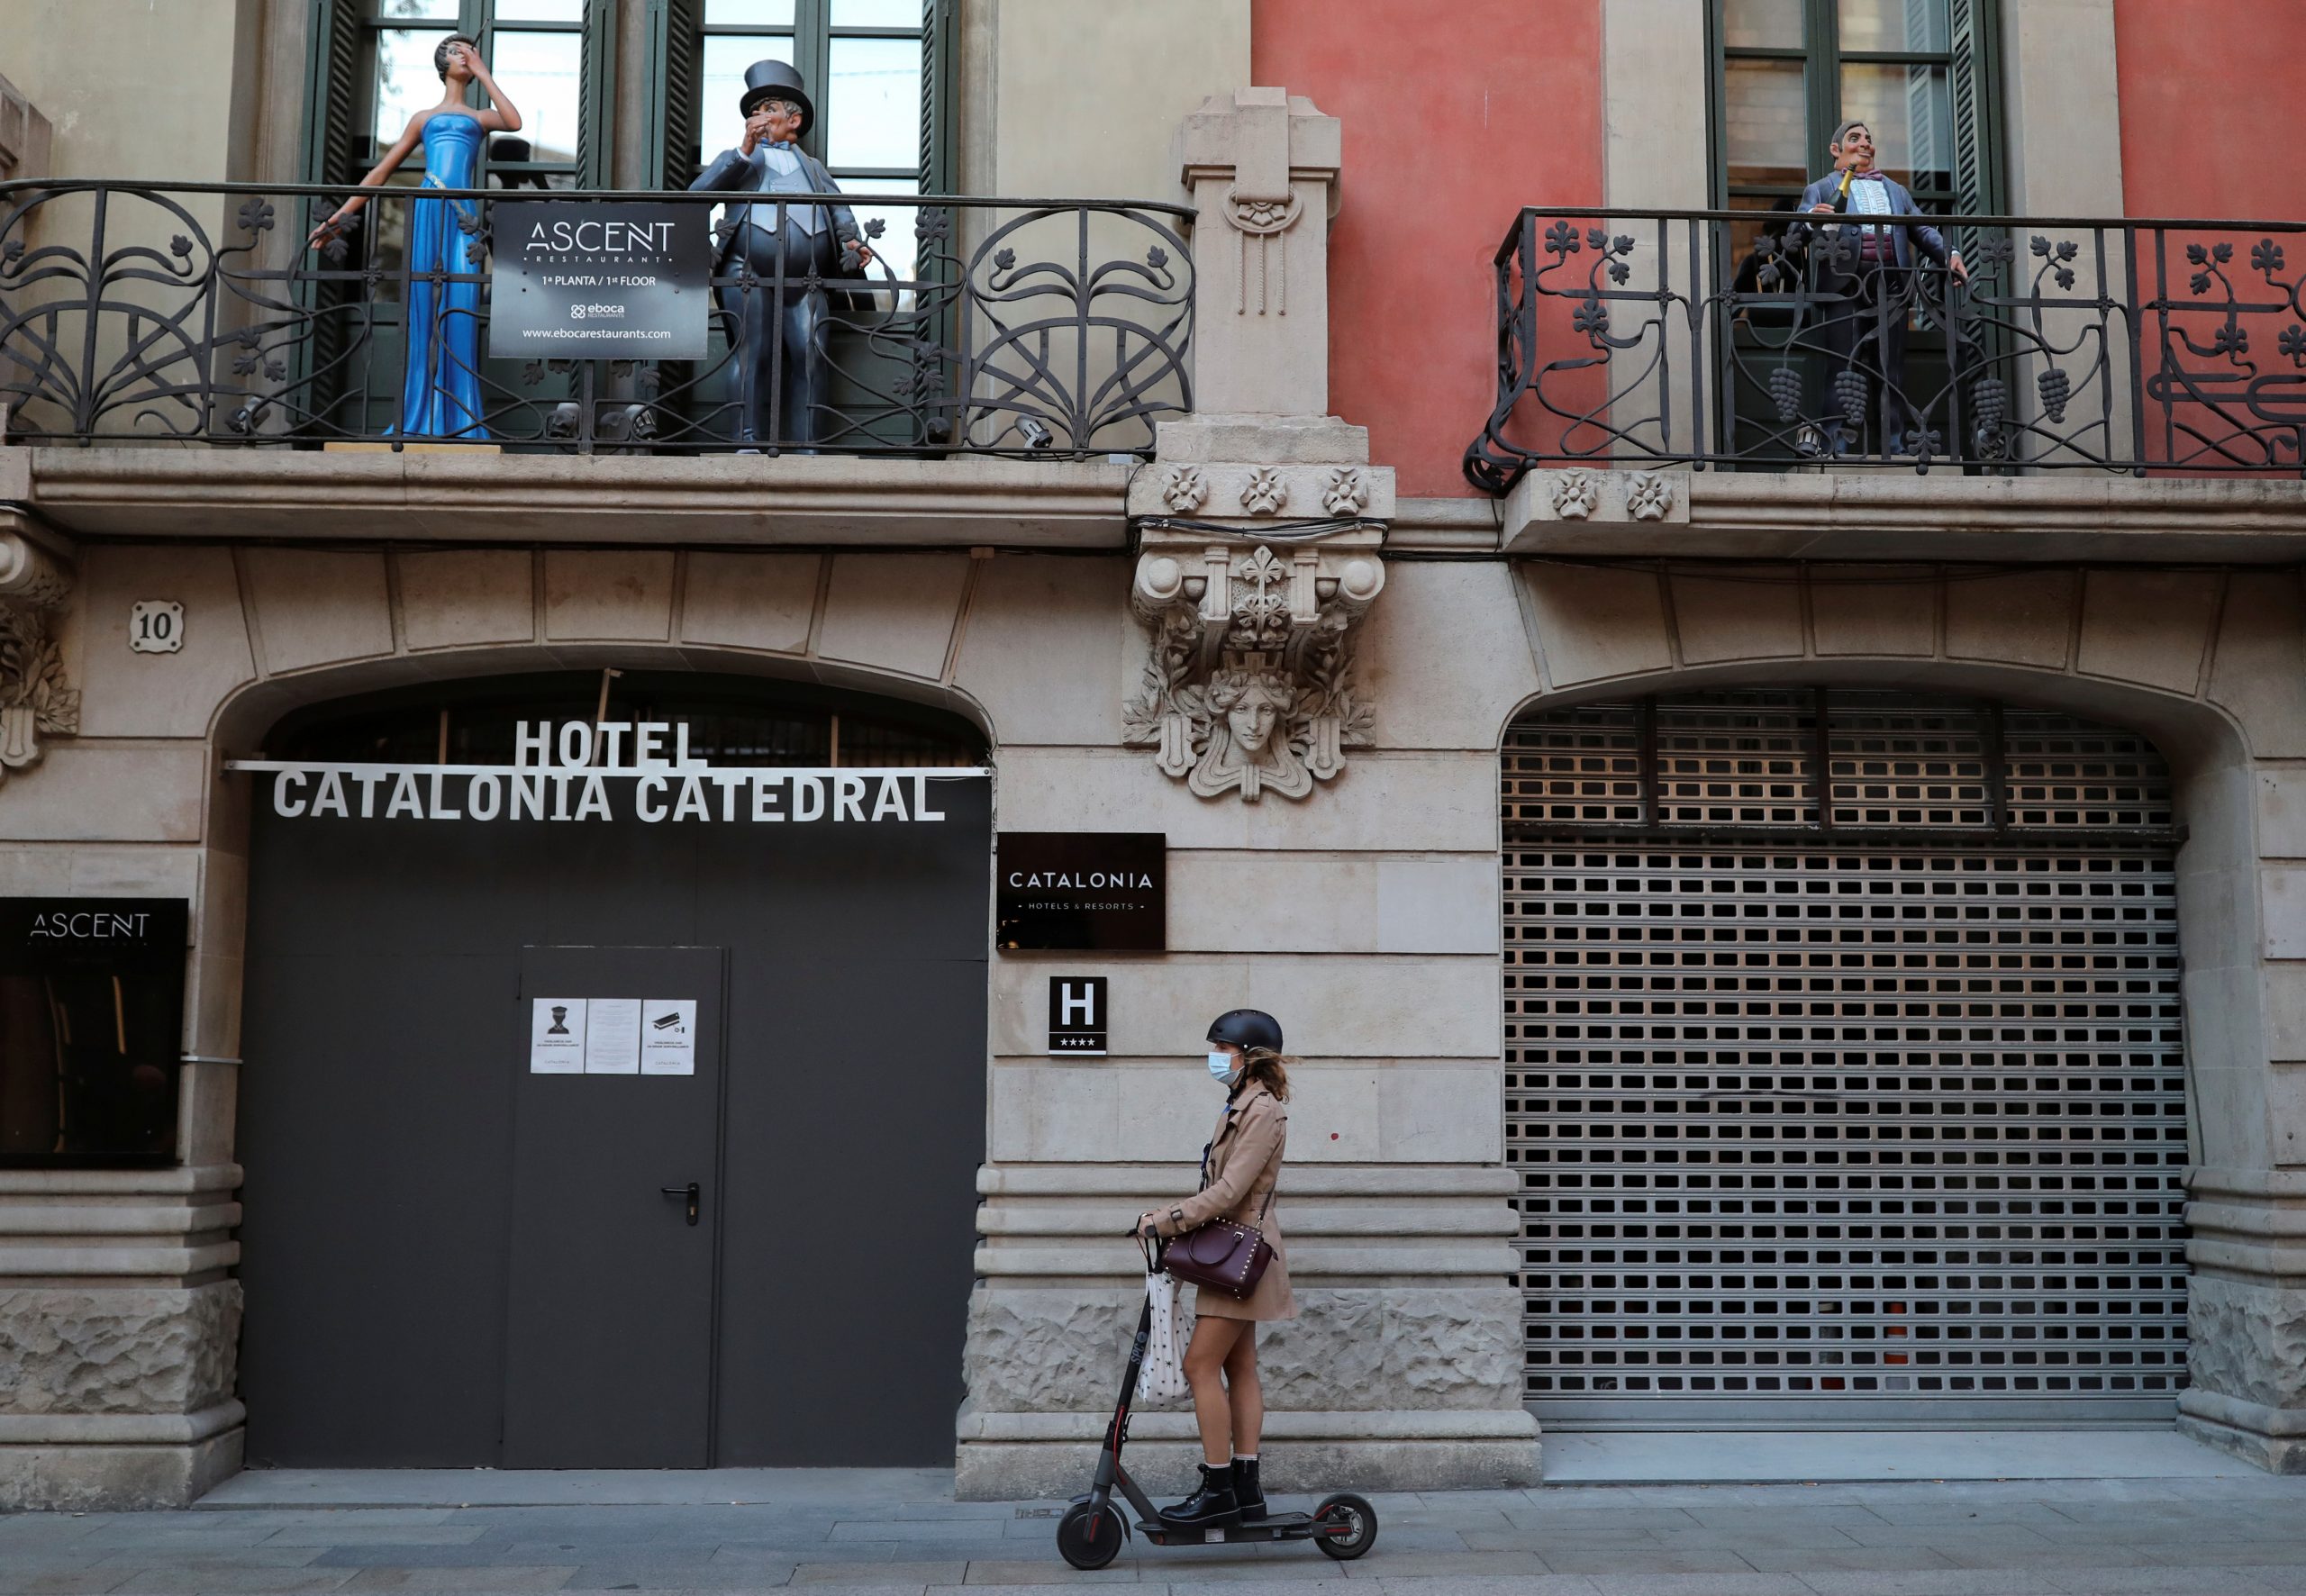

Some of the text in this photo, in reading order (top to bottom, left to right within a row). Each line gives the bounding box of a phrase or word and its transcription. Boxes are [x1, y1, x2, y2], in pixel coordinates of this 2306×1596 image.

[526, 221, 675, 252] ASCENT
[536, 255, 660, 263] RESTAURANT
[555, 276, 596, 286] PLANTA
[597, 276, 604, 286] /
[606, 276, 619, 286] 1st
[620, 276, 656, 286] FLOOR
[587, 303, 625, 313] eboca
[522, 328, 671, 340] www.ebocarestaurants.com
[140, 612, 171, 639] 10
[515, 721, 708, 768] HOTEL
[273, 768, 946, 823] CATALONIA CATEDRAL
[1009, 872, 1153, 888] CATALONIA
[30, 912, 150, 938] ASCENT
[1061, 983, 1094, 1026] H
